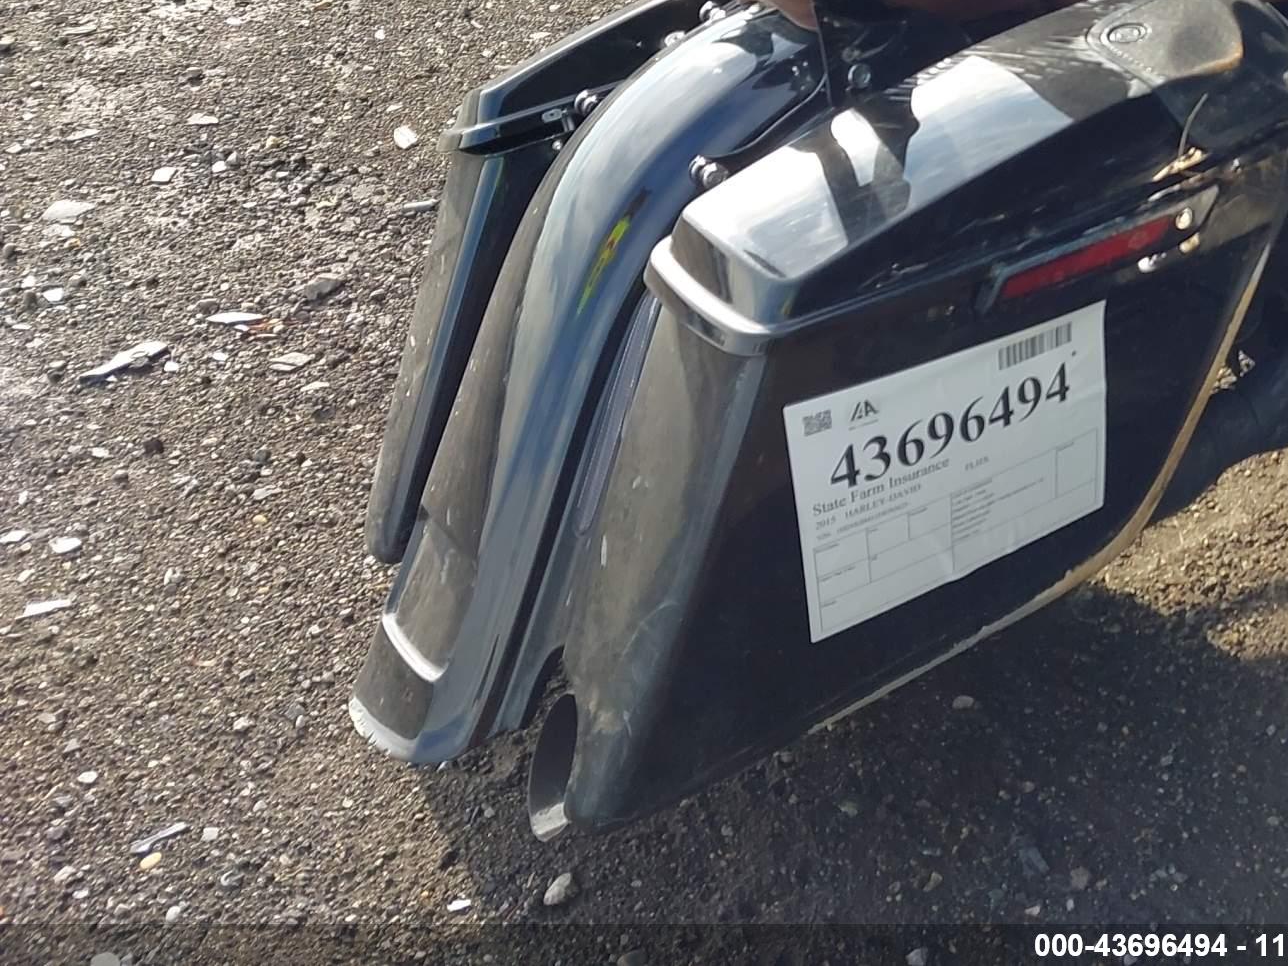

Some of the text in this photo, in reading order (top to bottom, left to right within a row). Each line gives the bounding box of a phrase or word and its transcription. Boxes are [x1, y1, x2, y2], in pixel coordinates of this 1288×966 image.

[830, 362, 1070, 489] 43696494
[812, 458, 950, 517] State Farm Insurance
